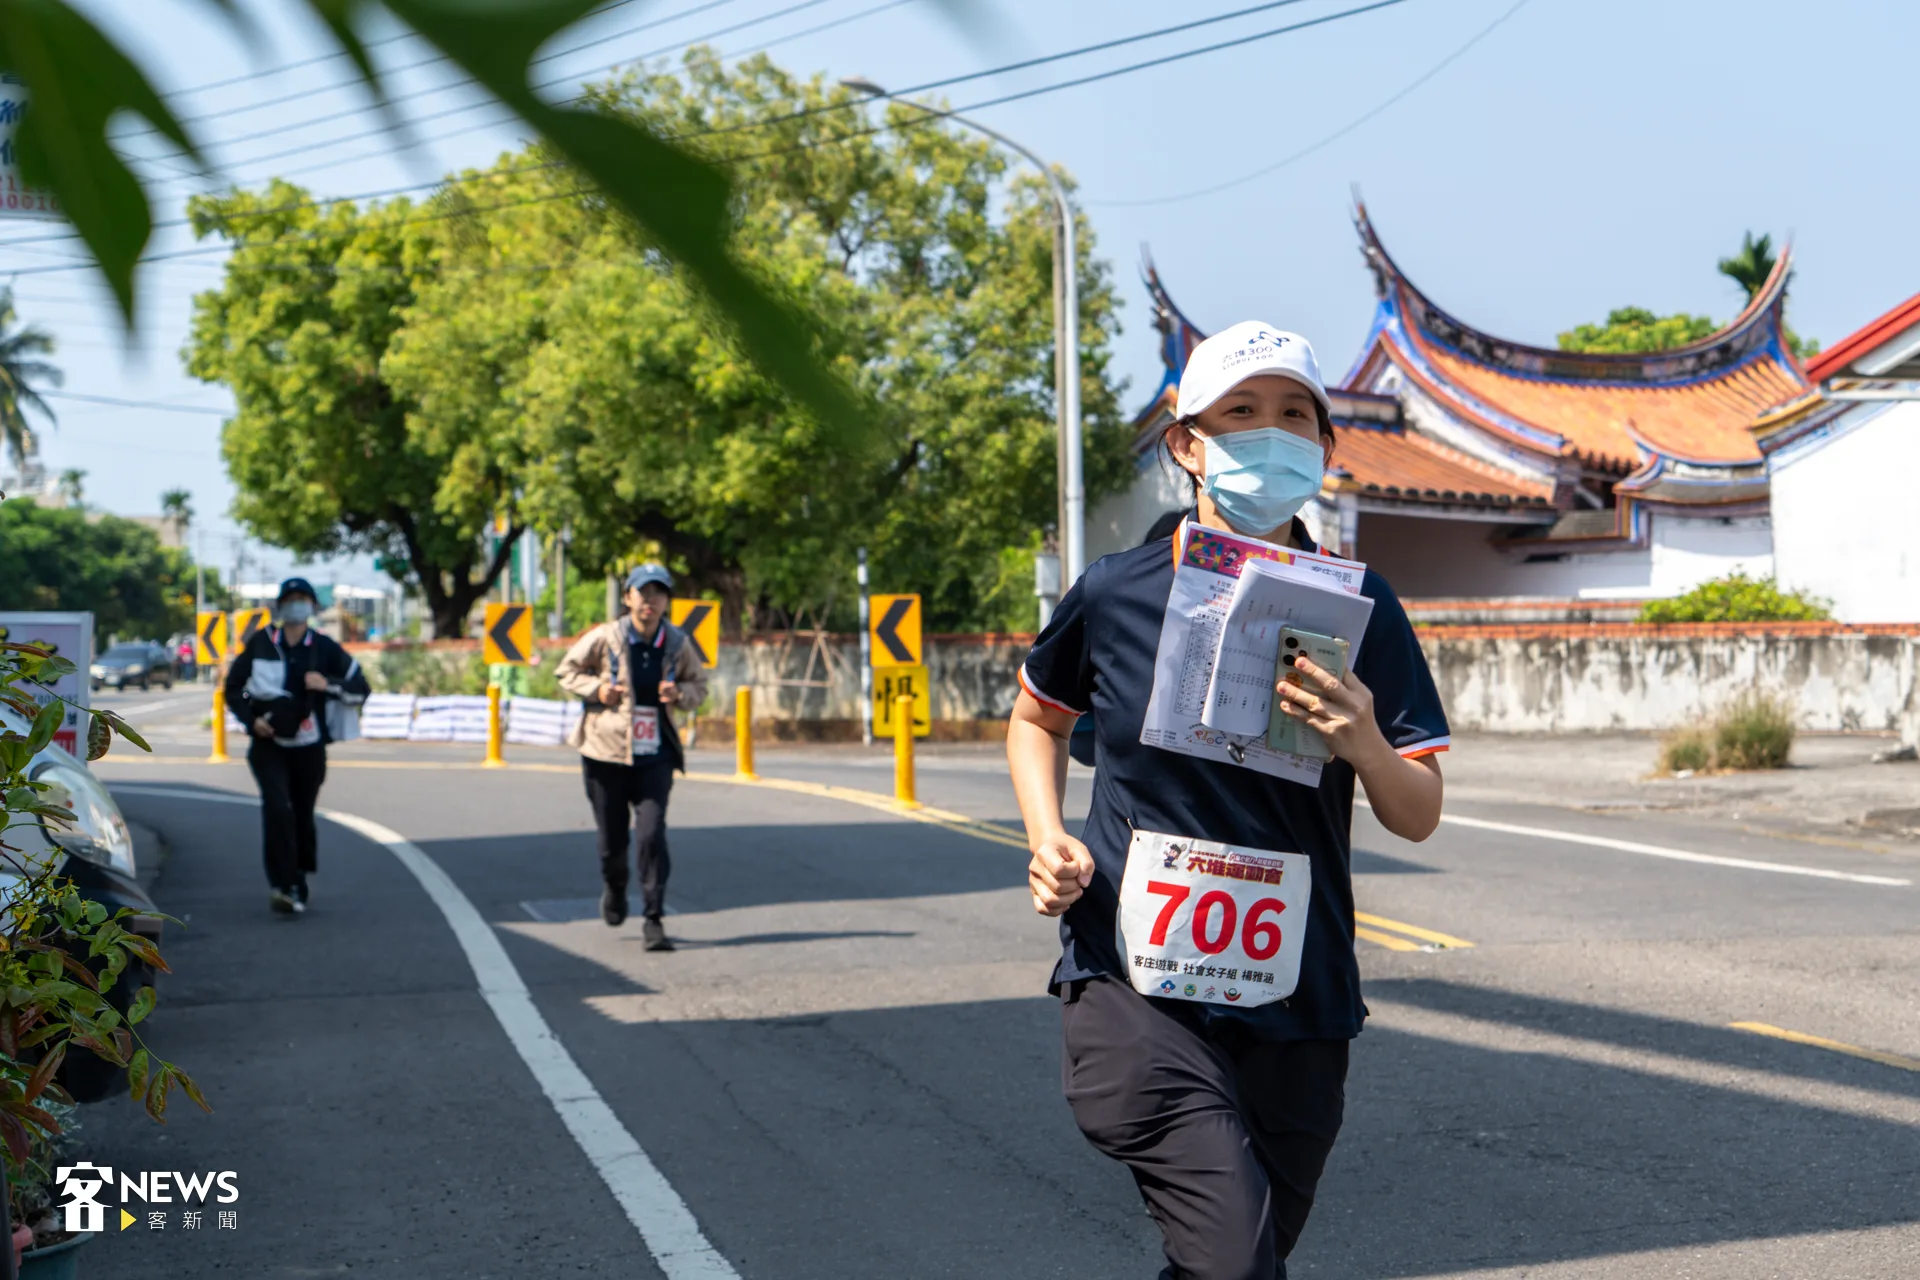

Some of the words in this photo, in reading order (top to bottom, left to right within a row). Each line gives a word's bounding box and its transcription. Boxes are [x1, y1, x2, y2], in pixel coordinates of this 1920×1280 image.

[1186, 856, 1284, 885] 六堆運動會
[1146, 880, 1287, 961] 706
[1134, 955, 1179, 972] 客庄遊戰
[1183, 962, 1238, 980] 社會女子組
[1242, 970, 1274, 984] 楊雅涵
